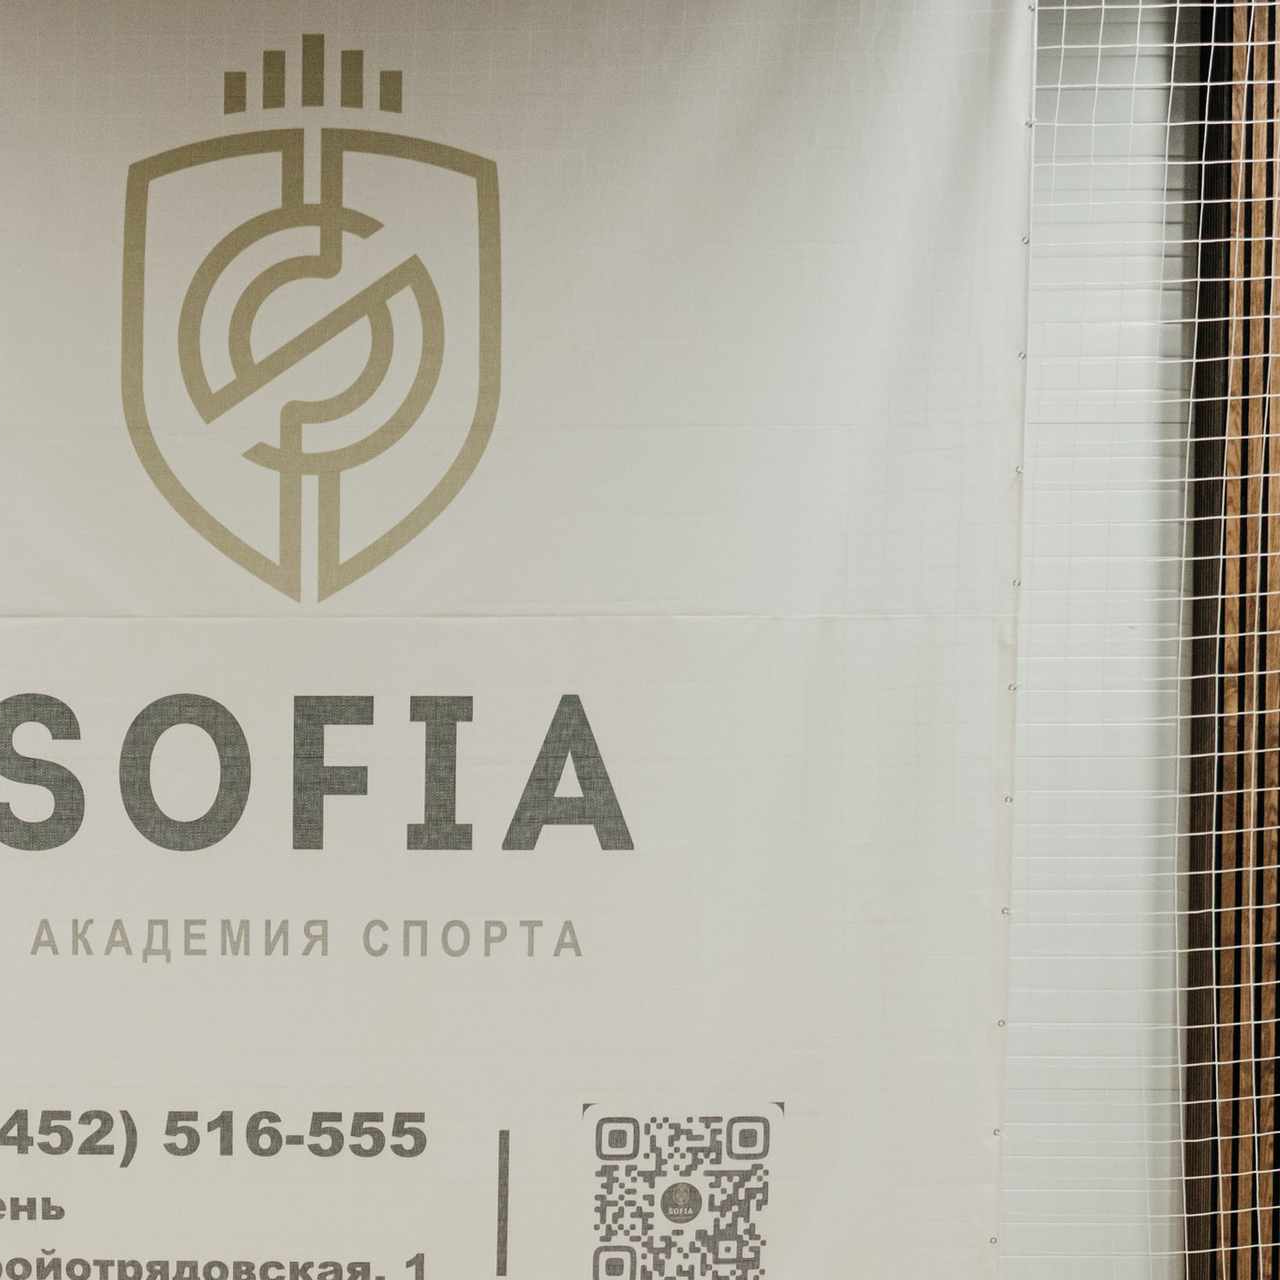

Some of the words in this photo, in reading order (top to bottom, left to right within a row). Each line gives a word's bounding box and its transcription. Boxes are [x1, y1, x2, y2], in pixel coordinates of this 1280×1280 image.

[31, 917, 331, 964] АКАДЕМИЯ
[362, 919, 584, 959] СПОРТА
[163, 1110, 430, 1160] 516-555
[668, 1207, 694, 1215] SOFIA
